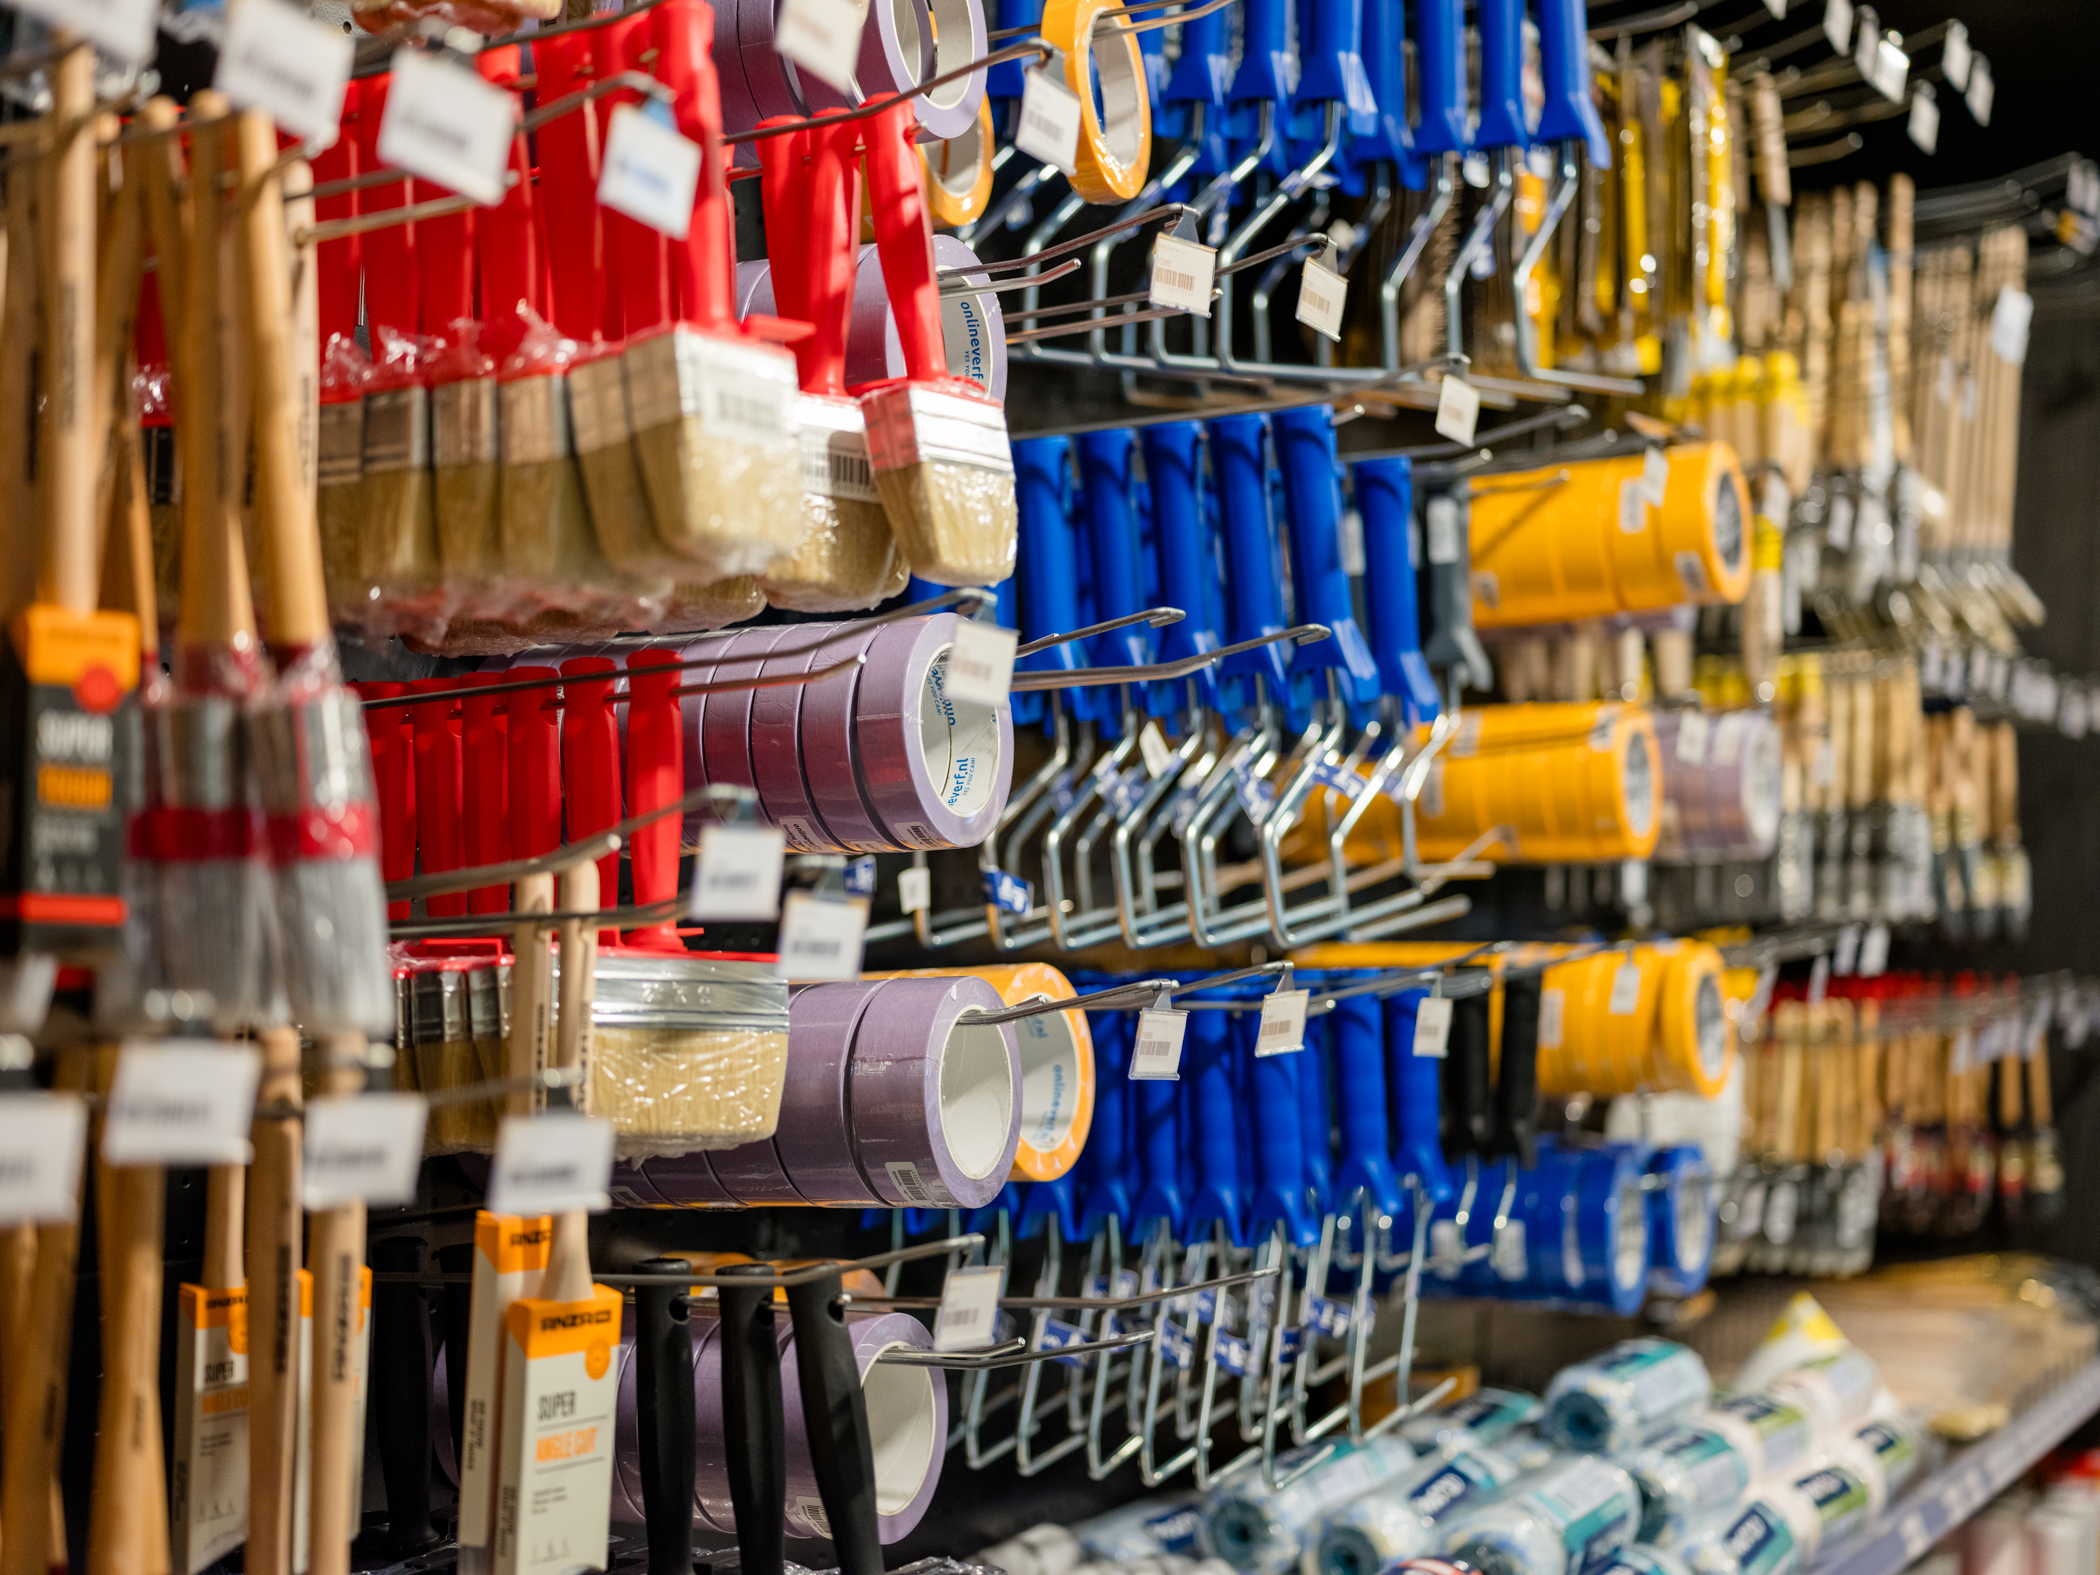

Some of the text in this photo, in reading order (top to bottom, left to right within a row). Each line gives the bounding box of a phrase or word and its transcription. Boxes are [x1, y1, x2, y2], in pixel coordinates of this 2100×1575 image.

[960, 302, 984, 384] onlineverf.
[537, 1390, 577, 1422] SUPER
[534, 1427, 597, 1463] ANGLE CUT
